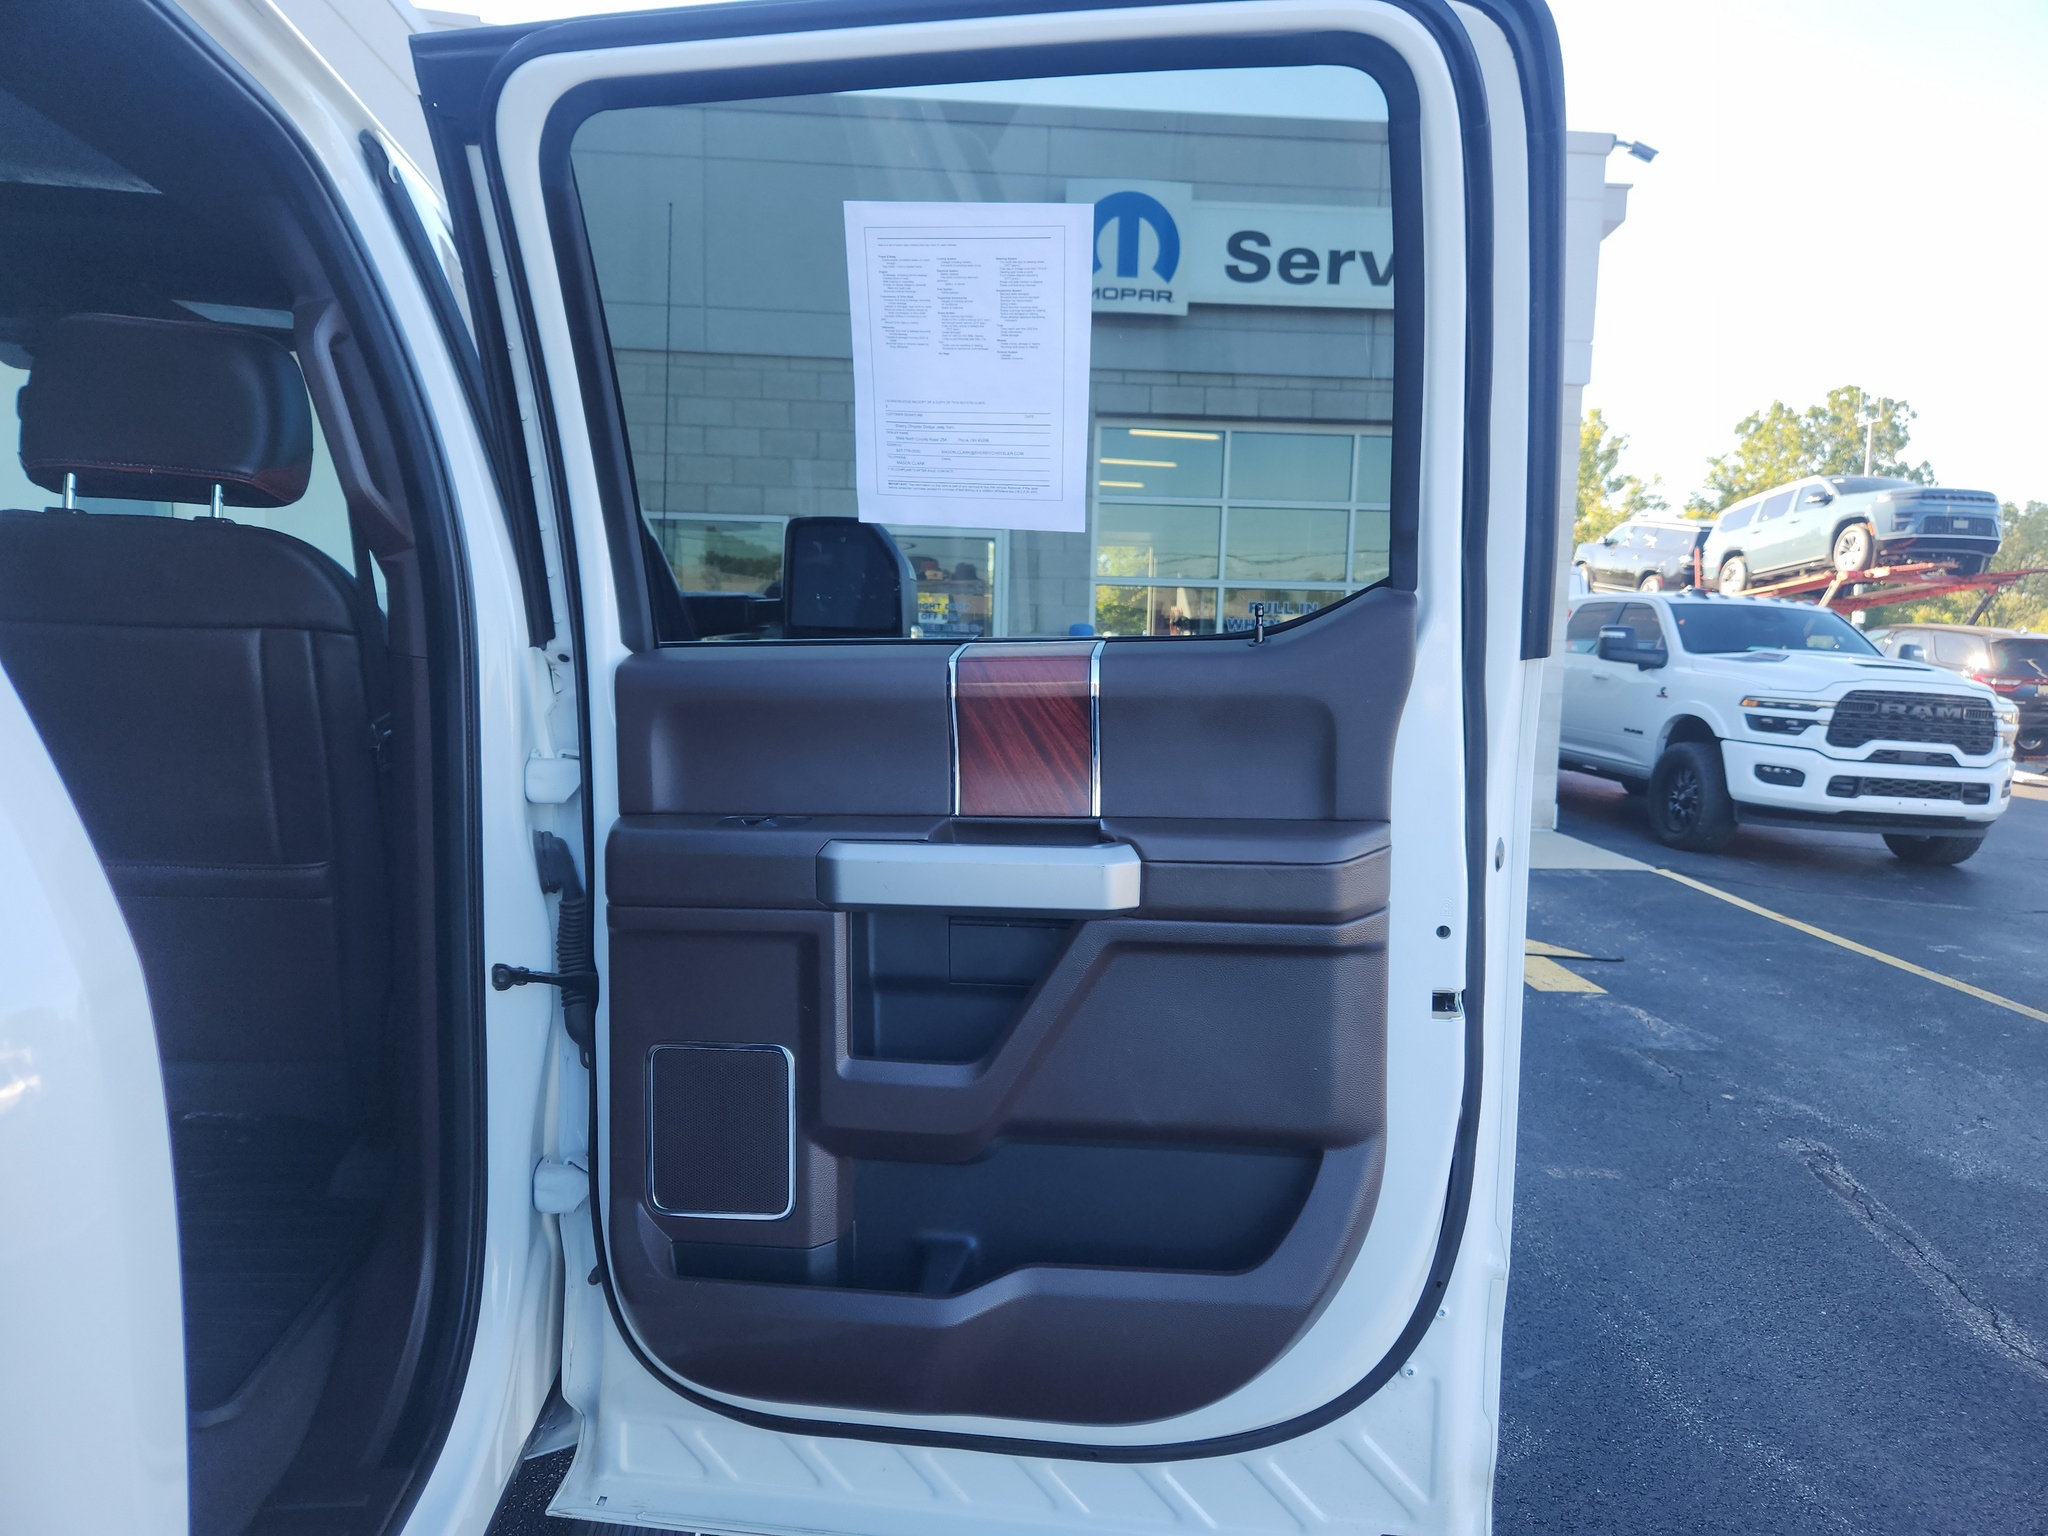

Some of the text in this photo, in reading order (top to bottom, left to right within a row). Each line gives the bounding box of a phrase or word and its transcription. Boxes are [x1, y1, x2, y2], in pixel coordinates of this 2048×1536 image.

[1224, 230, 1394, 286] Serv
[1248, 600, 1319, 615] PULL IN
[1881, 702, 1962, 720] RAM
